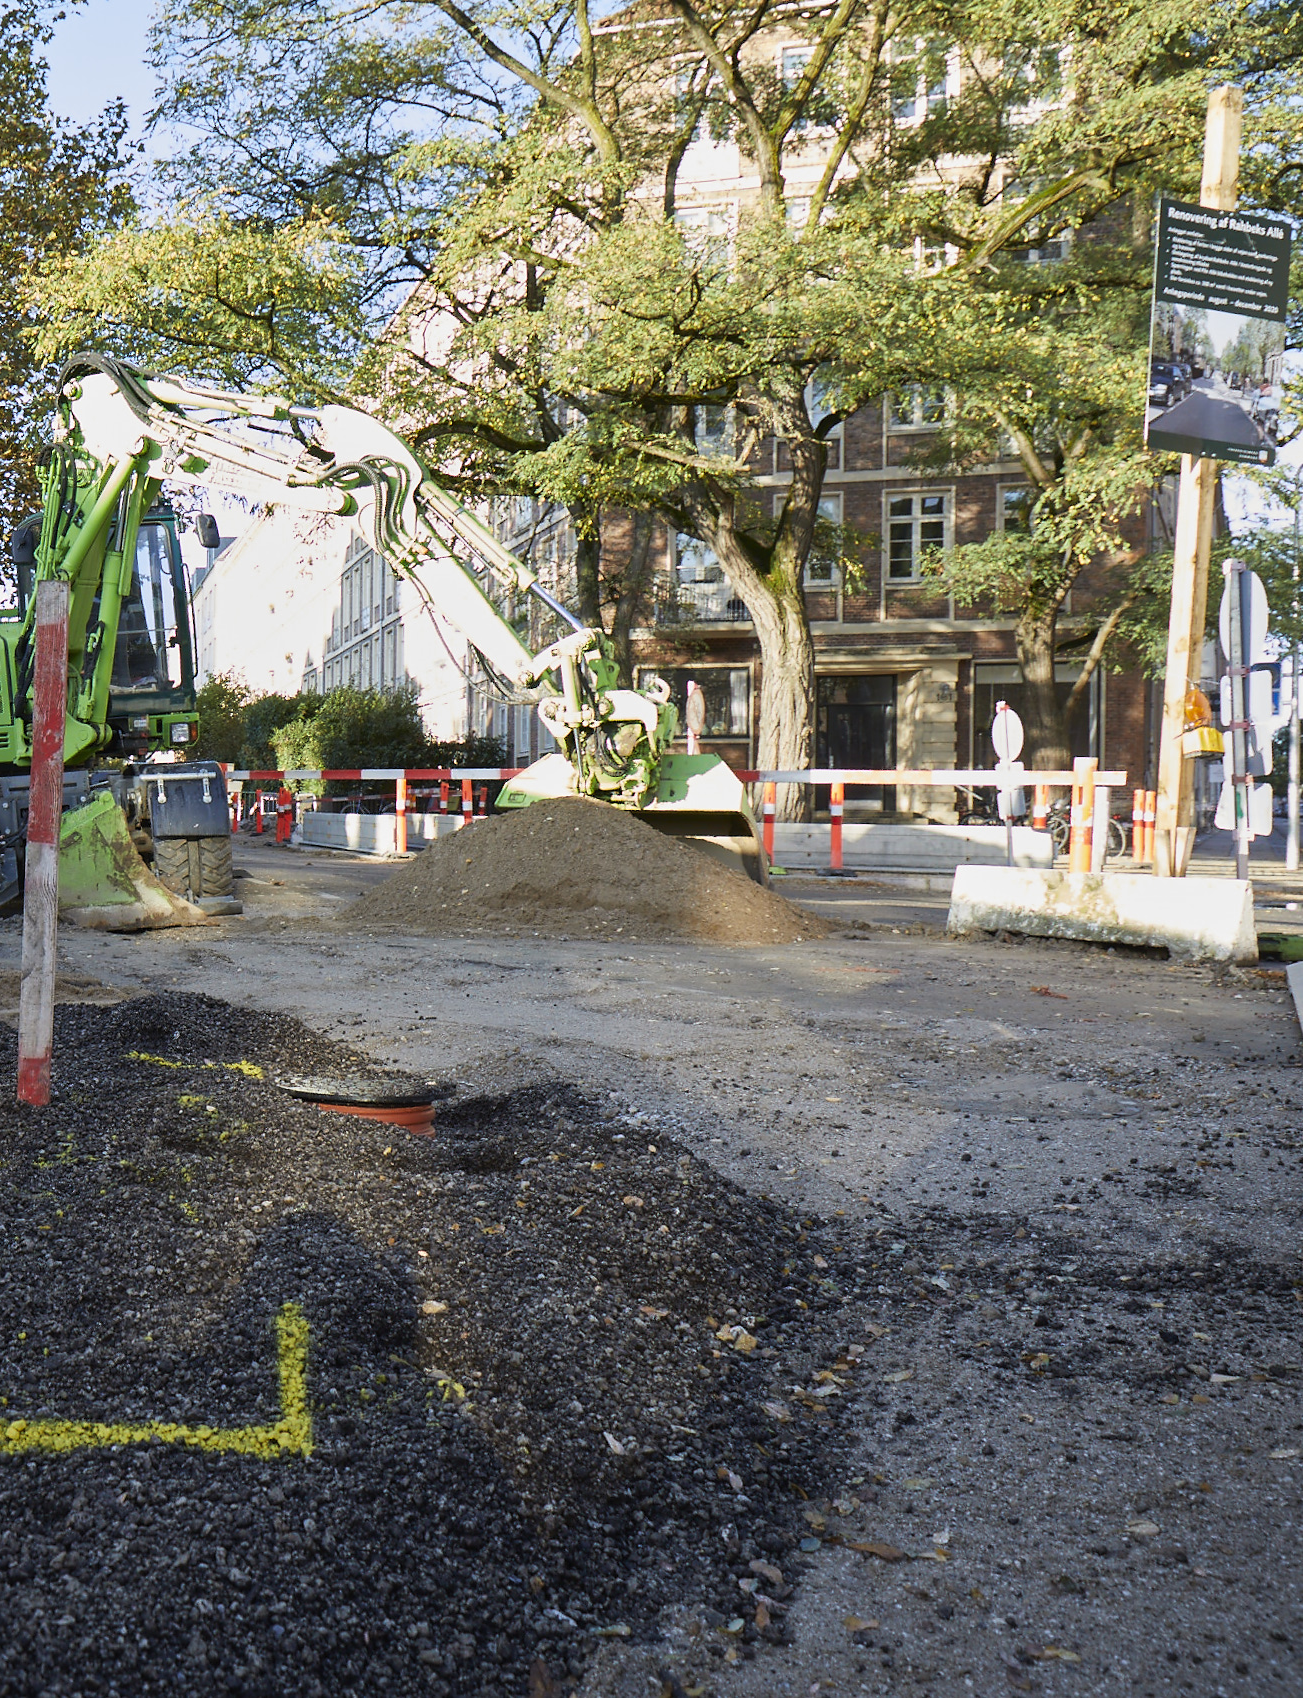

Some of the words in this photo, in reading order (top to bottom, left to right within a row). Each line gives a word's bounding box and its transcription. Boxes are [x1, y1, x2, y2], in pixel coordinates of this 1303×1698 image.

[1168, 207, 1218, 229] Renovering
[1218, 216, 1229, 229] af
[1229, 218, 1266, 237] Rahbeks
[1234, 298, 1262, 312] december
